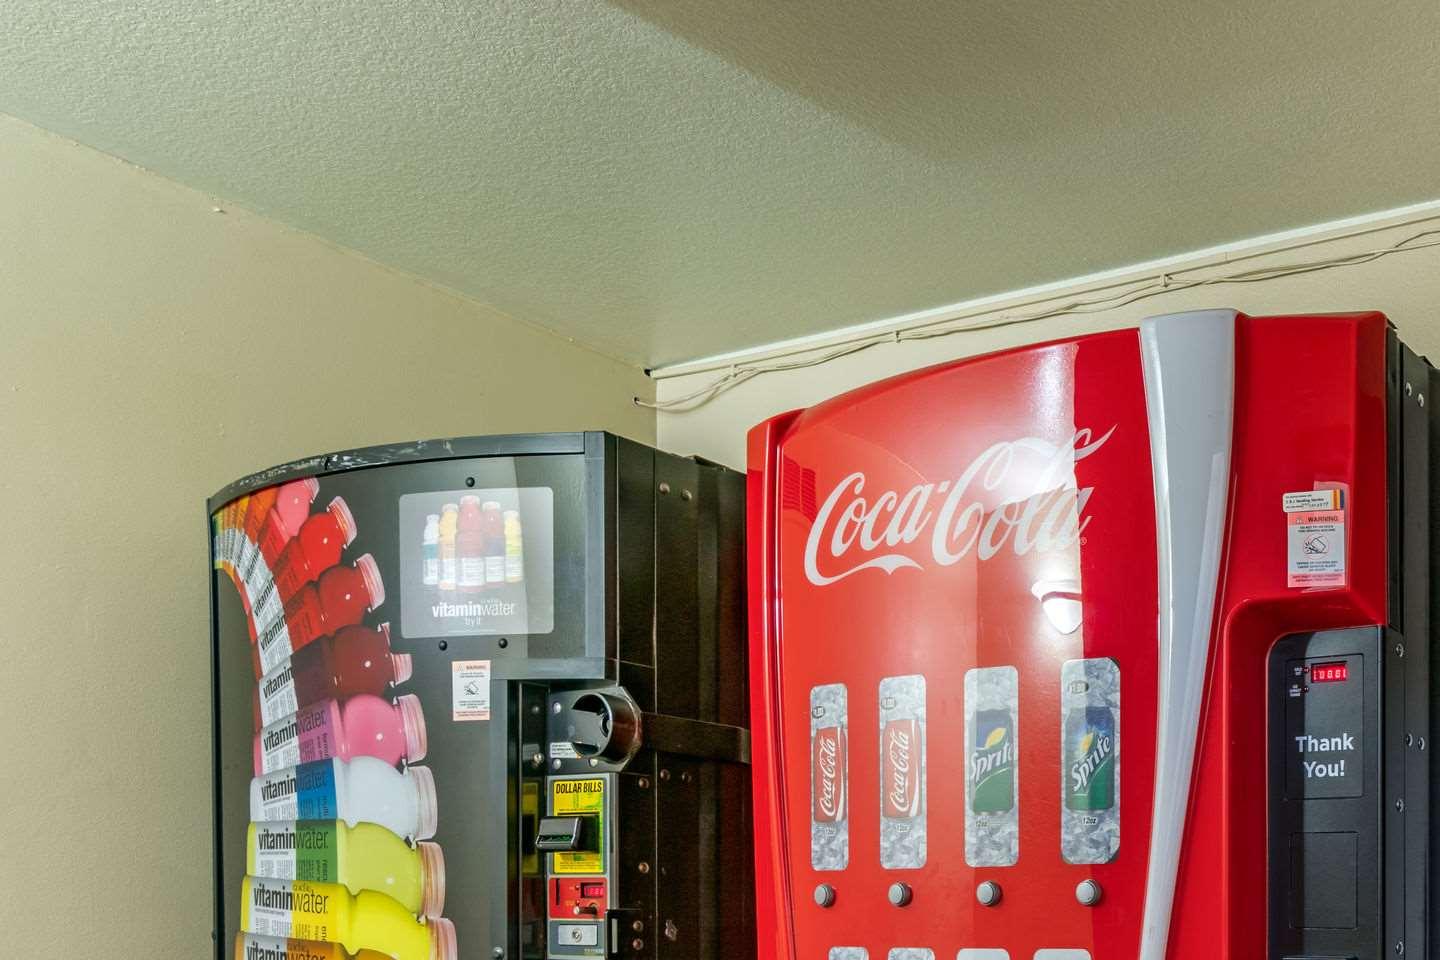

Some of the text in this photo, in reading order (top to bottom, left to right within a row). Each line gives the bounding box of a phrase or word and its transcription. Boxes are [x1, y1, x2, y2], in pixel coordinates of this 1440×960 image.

[805, 424, 1118, 586] Coca-Cola
[432, 602, 515, 617] vitaminwater
[1295, 733, 1354, 752] Thank
[971, 742, 1016, 782] Sprite
[1072, 737, 1110, 791] Sprite
[1304, 760, 1345, 778] You!
[556, 781, 602, 794] DOLLAR BILLS
[259, 828, 328, 850] vitaminwater
[254, 883, 328, 914] vitaminwater
